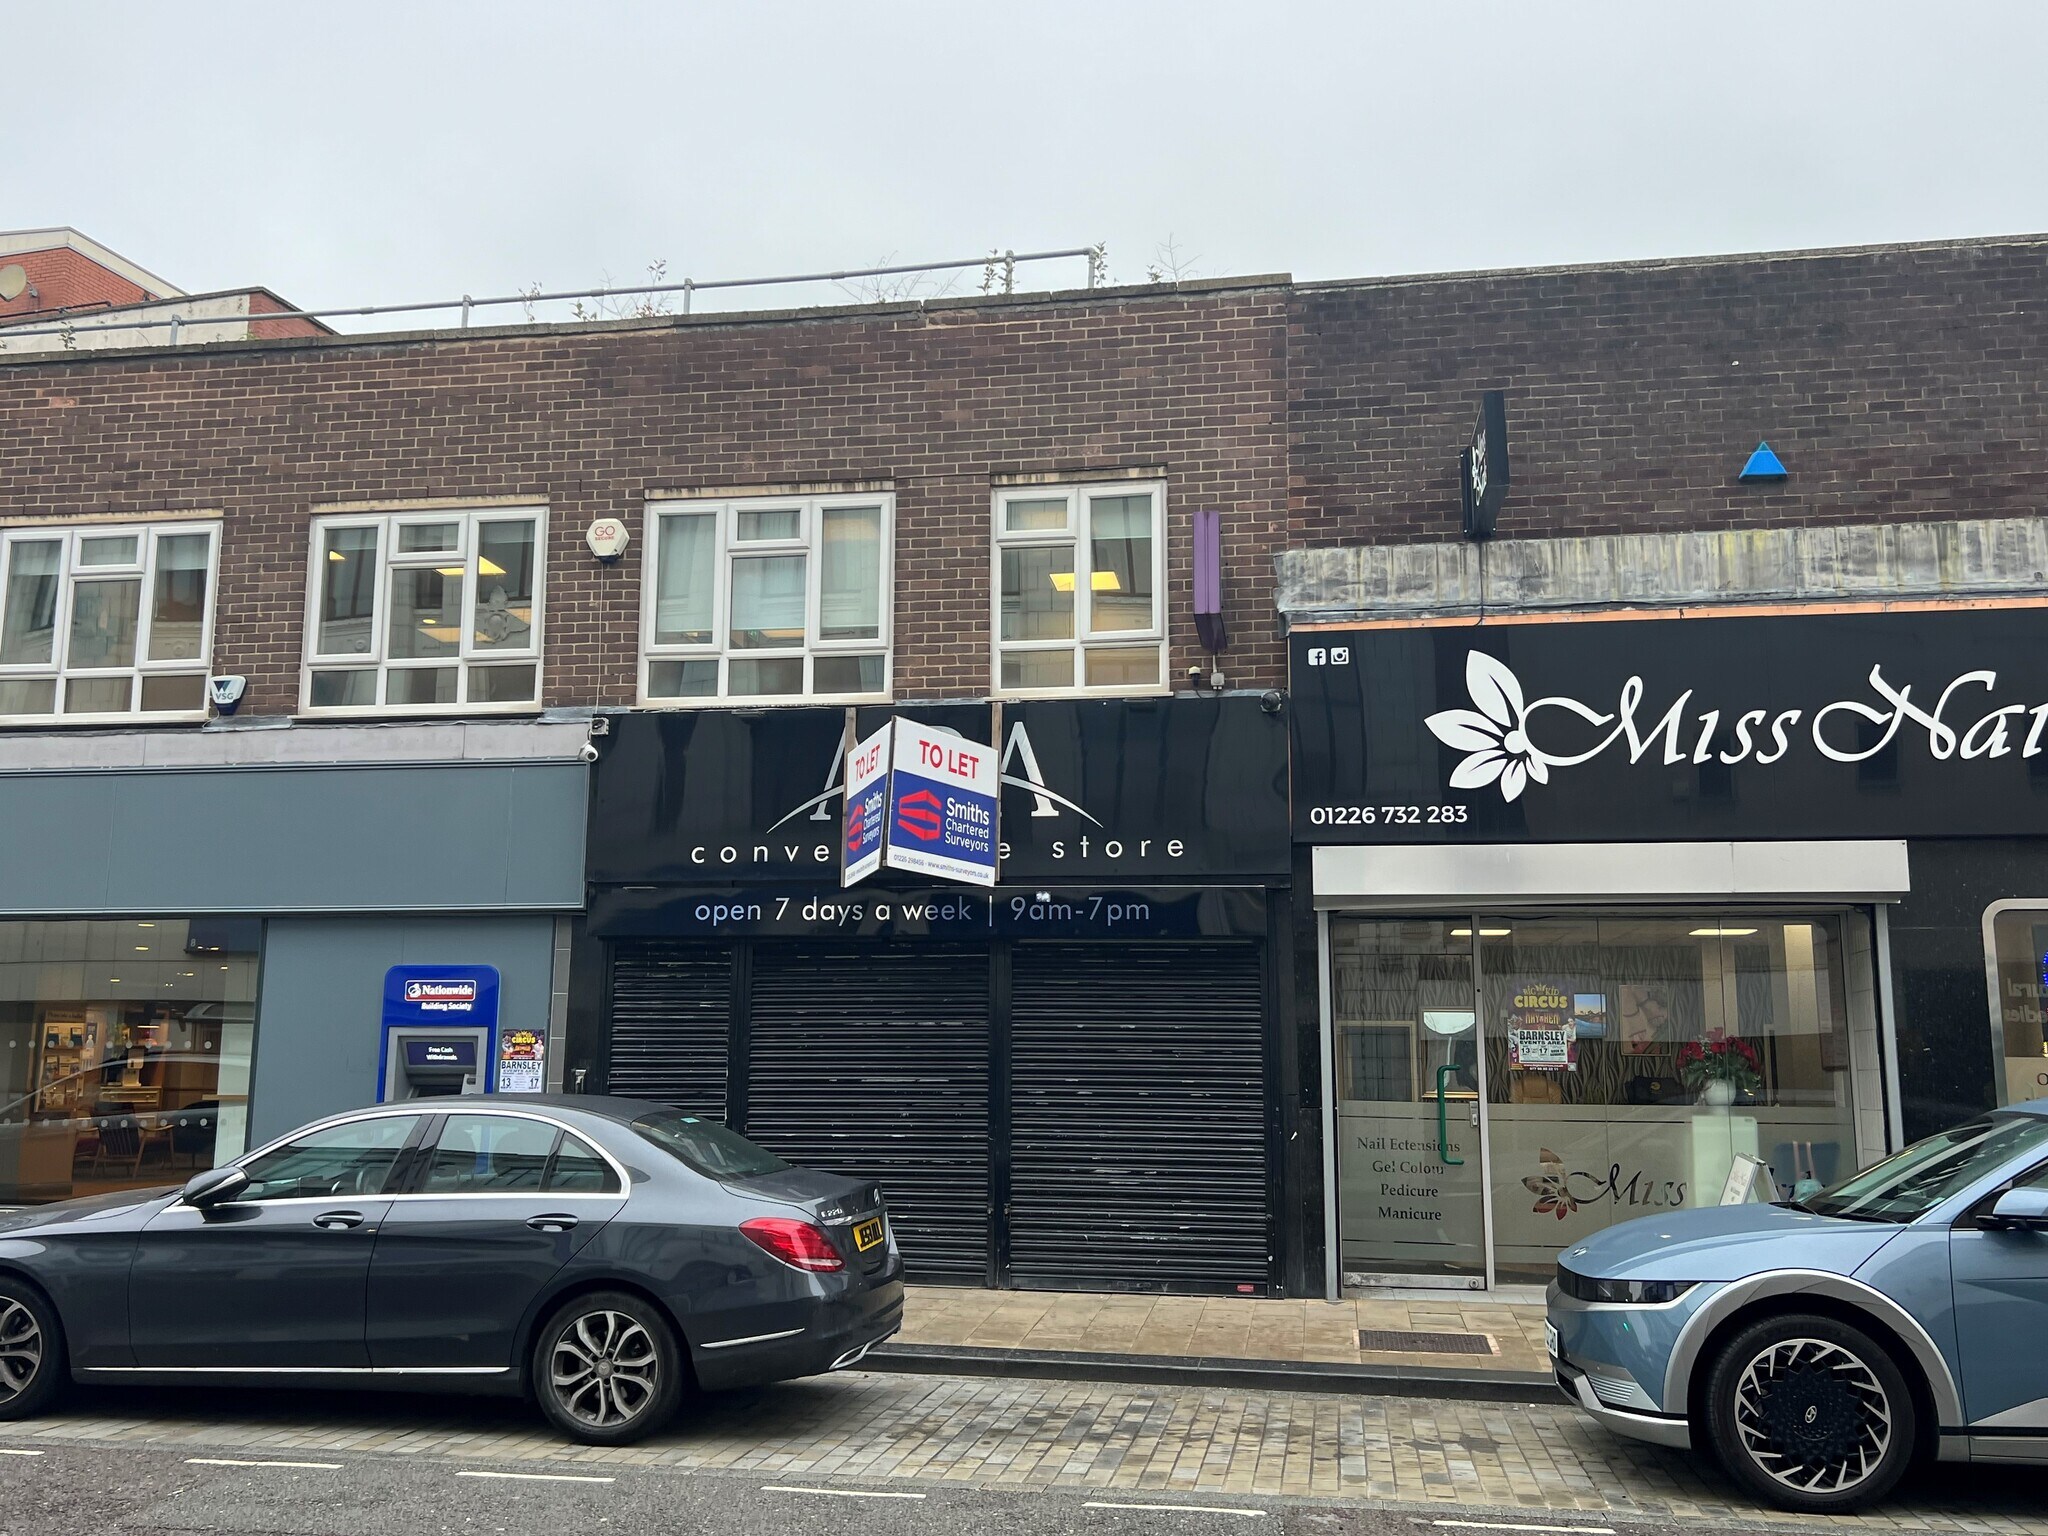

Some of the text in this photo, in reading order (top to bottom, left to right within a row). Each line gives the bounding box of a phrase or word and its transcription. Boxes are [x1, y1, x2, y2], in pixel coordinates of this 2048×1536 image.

[594, 525, 615, 537] GO
[215, 692, 234, 700] VSG
[1523, 675, 1802, 766] Miss
[855, 743, 880, 782] TO LET
[919, 739, 979, 779] TO LET
[864, 790, 882, 817] Smiths
[946, 796, 989, 825] Smiths
[1310, 805, 1468, 825] 01226 732 283
[862, 825, 880, 845] Surveyors
[945, 818, 989, 839] Chartered
[944, 831, 989, 853] Surveyors
[1052, 835, 1184, 860] store
[694, 904, 761, 927] open
[775, 897, 790, 921] 7
[802, 896, 863, 927] days
[875, 904, 890, 921] a
[901, 895, 972, 921] week
[1010, 896, 1150, 927] 9am-7pm
[422, 984, 473, 995] Nationwide
[1545, 985, 1560, 995] KID
[421, 1002, 472, 1011] Building Society
[1513, 995, 1568, 1009] CIRCUS
[511, 1036, 536, 1044] CIRCUS
[1519, 1030, 1565, 1041] BARNSLEY
[501, 1061, 542, 1070] BARNSLEY
[501, 1077, 511, 1087] 13
[529, 1077, 539, 1088] 17
[1357, 1137, 1386, 1150] Nail
[1372, 1160, 1395, 1173] Gel
[1380, 1183, 1439, 1197] Pedicure
[1566, 1163, 1688, 1206] Miss
[1378, 1206, 1442, 1221] Manicure
